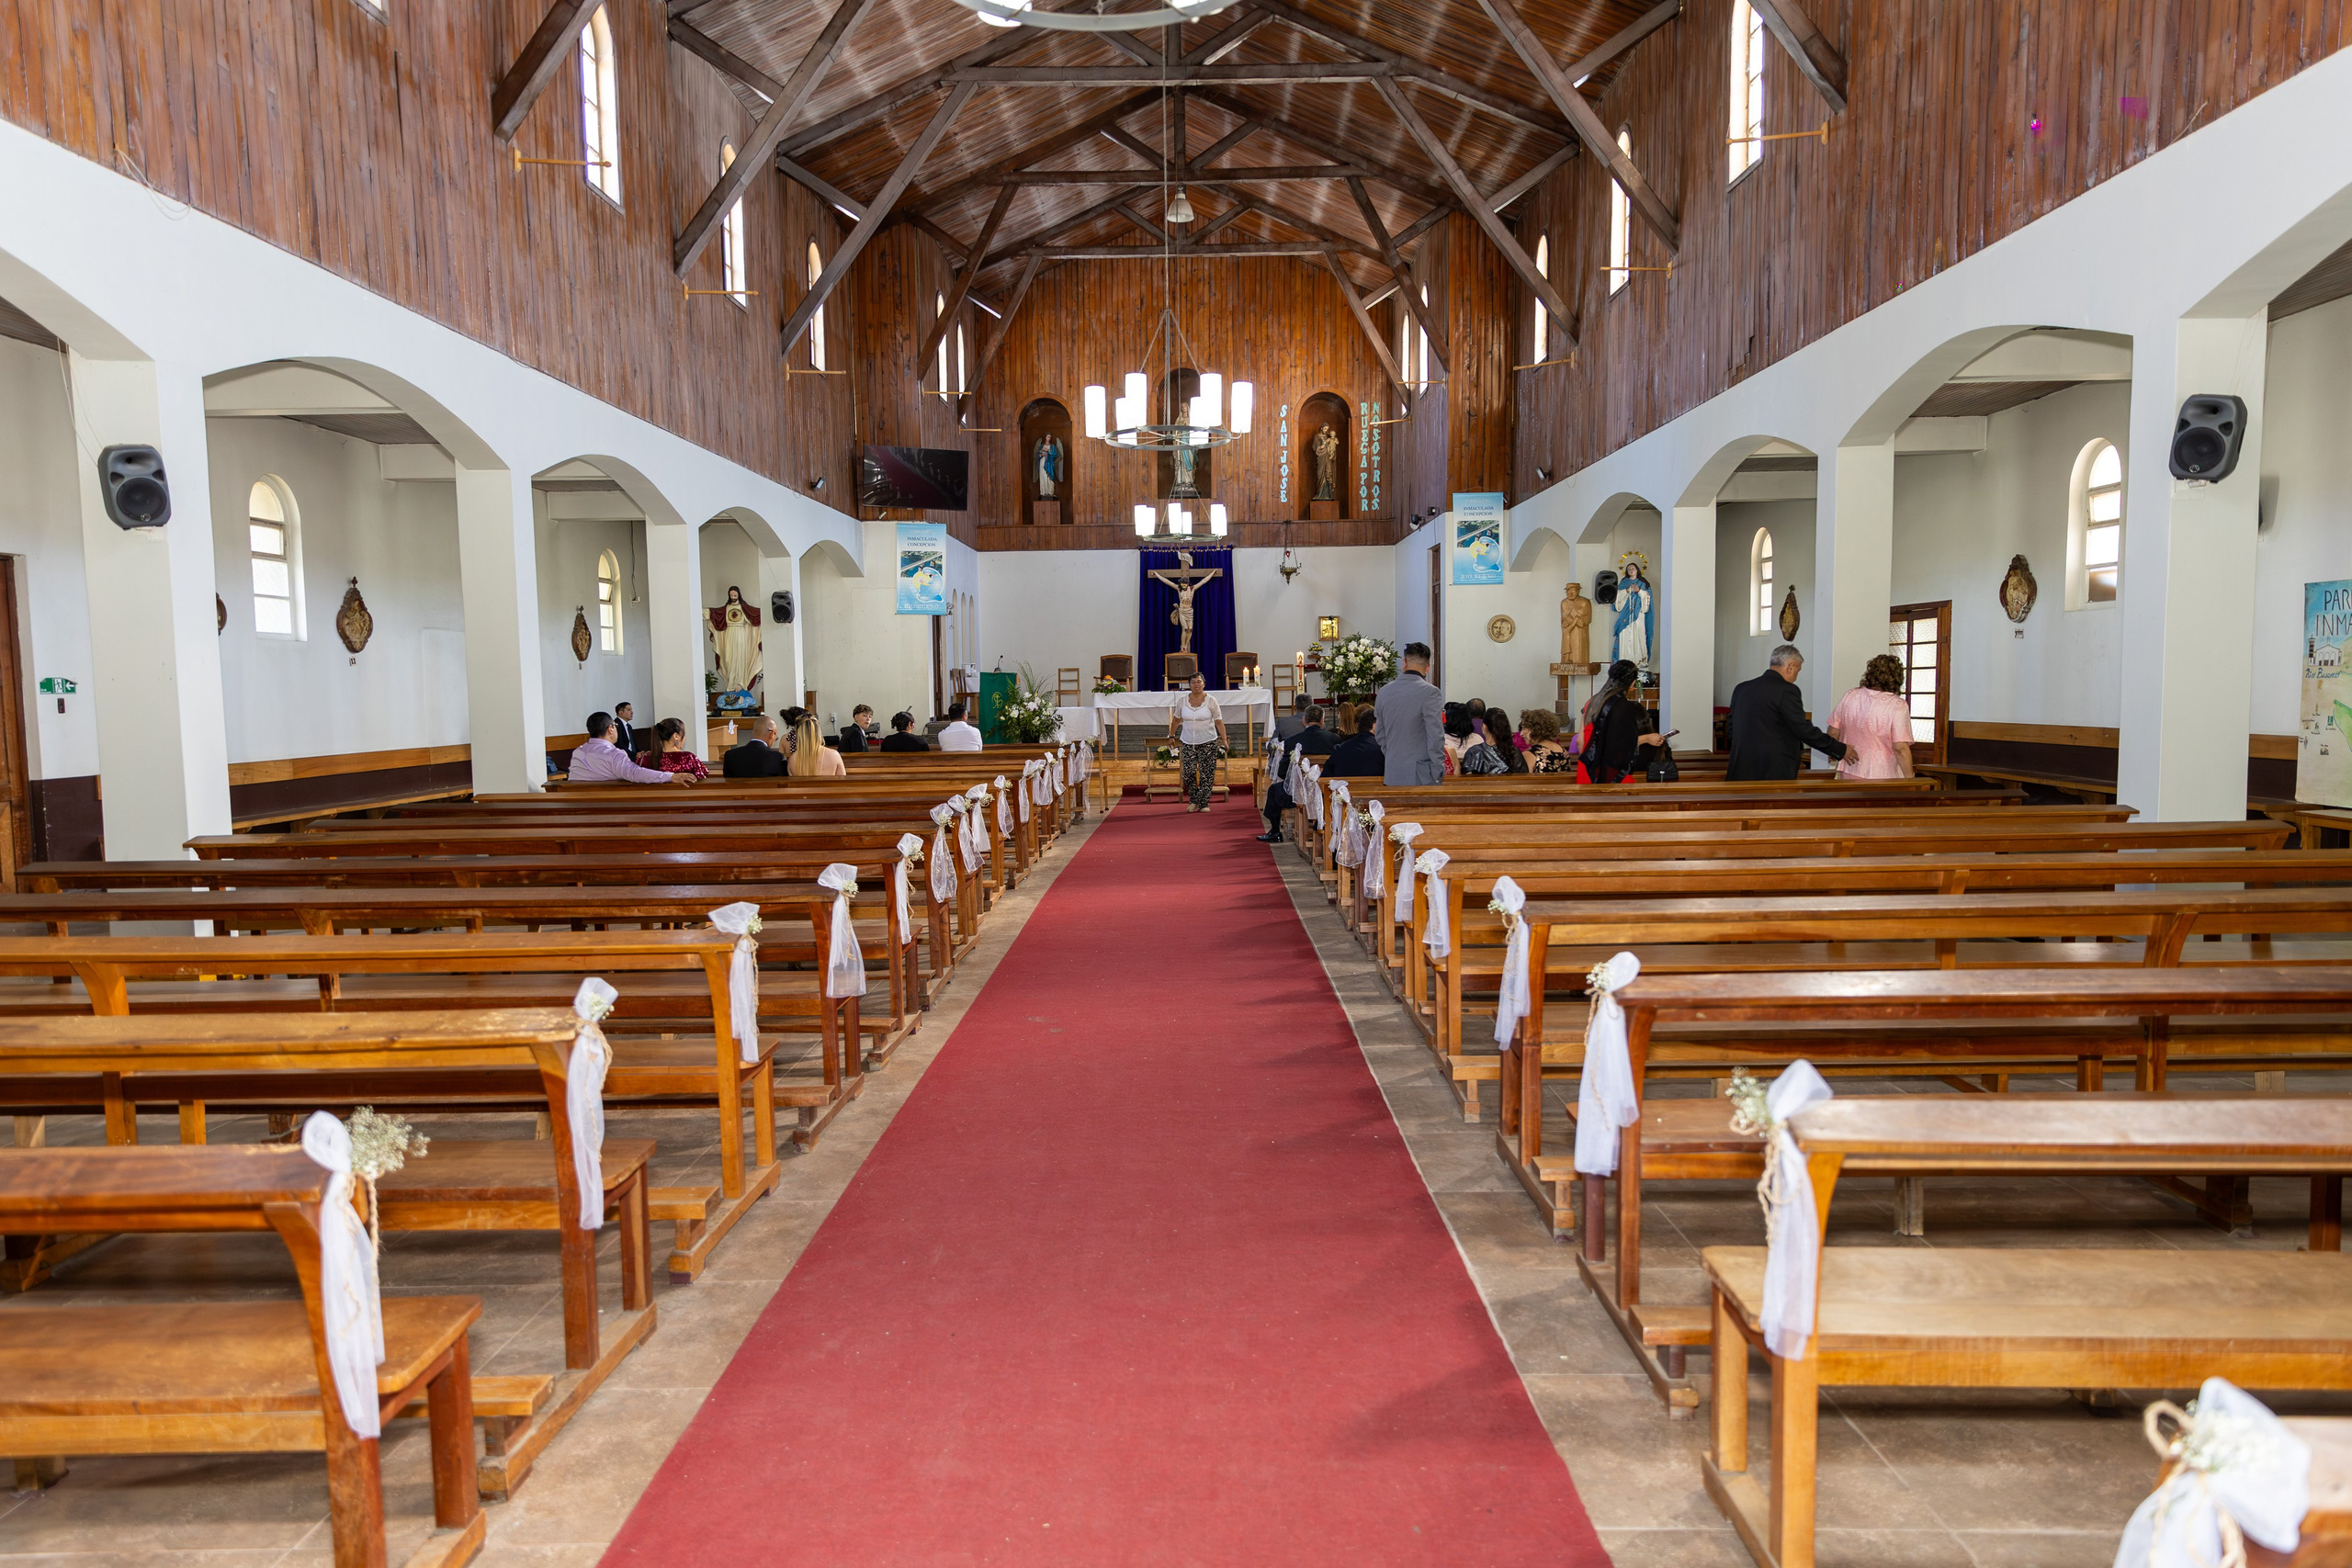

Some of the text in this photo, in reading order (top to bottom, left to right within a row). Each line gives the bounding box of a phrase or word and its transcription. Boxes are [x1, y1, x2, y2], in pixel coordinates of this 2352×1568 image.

[1280, 405, 1289, 503] SAN JOSE
[1360, 402, 1368, 512] RUEGA POR
[1372, 401, 1381, 511] NOSOTROS
[2324, 589, 2352, 611] PAR
